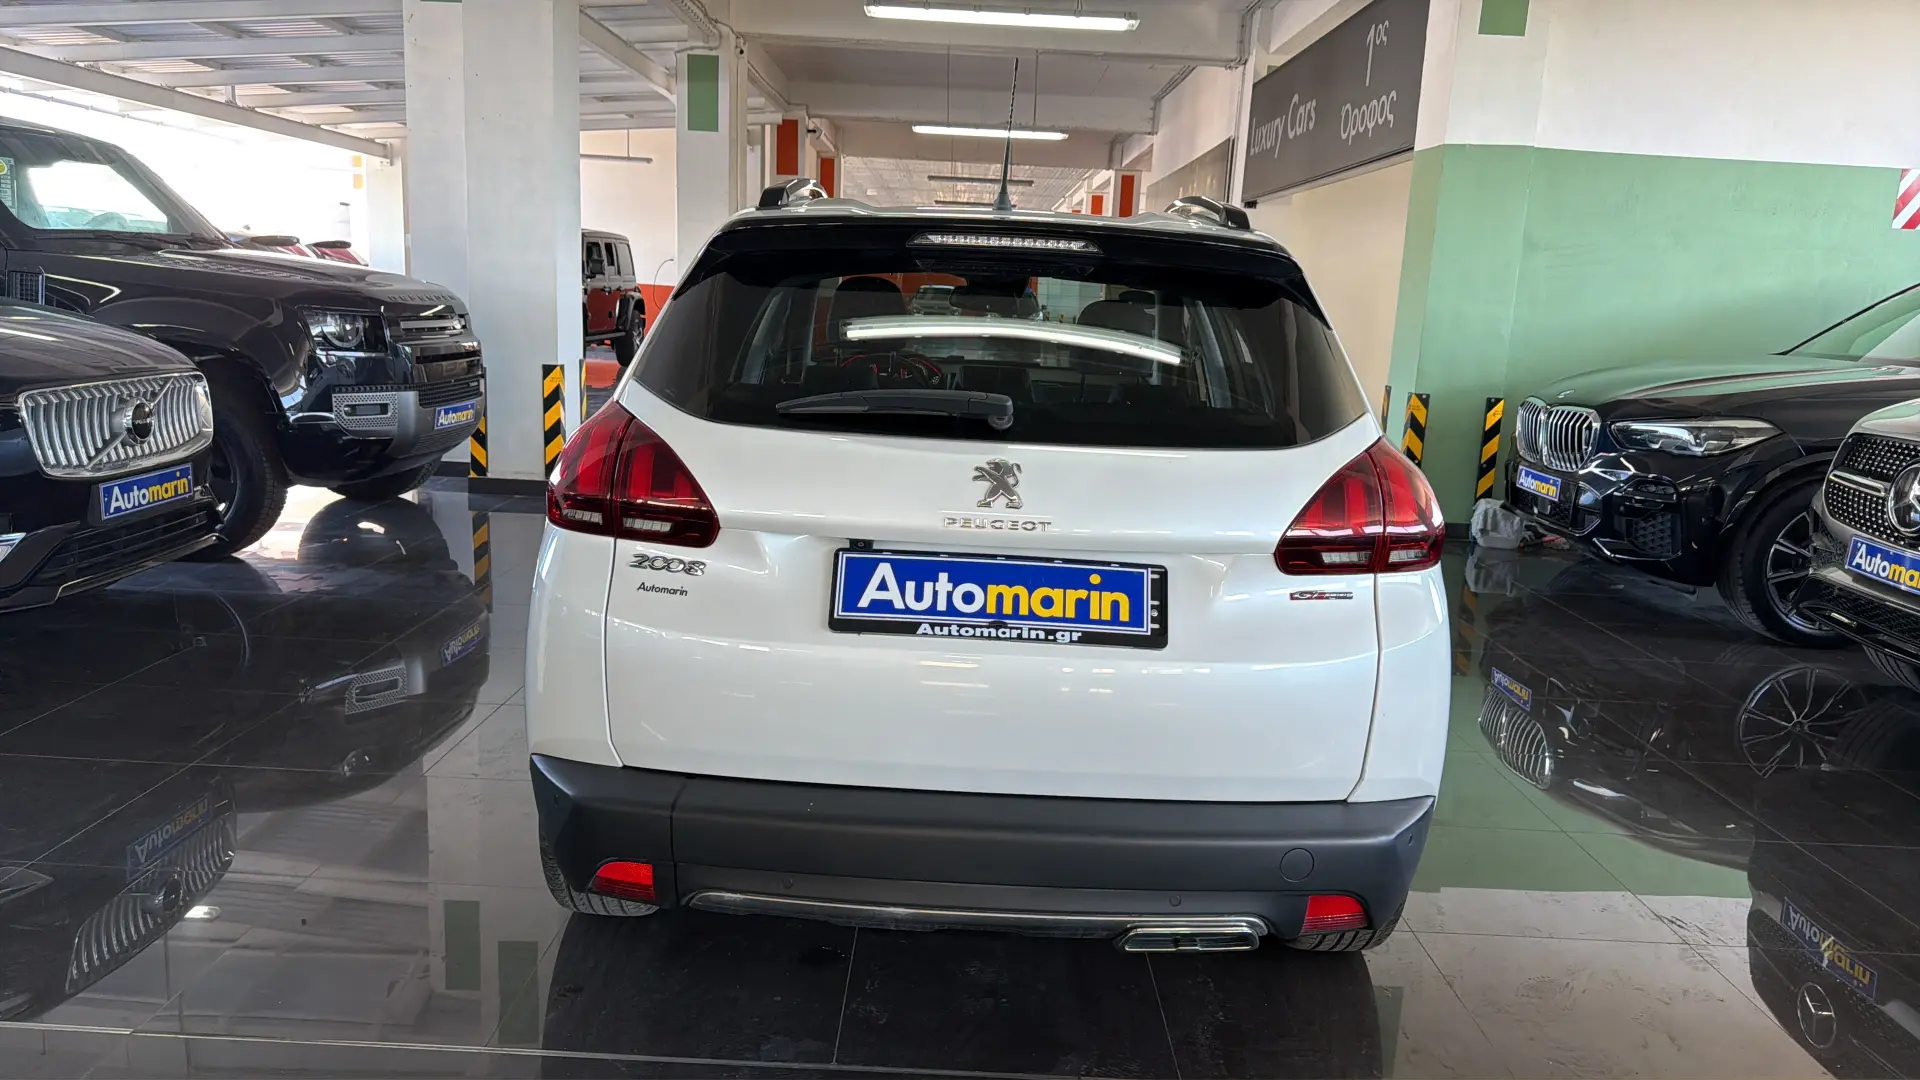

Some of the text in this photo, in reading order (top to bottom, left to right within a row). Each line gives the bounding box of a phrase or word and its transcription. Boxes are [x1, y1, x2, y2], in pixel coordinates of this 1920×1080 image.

[1250, 93, 1317, 158] Luxury Cars
[438, 404, 474, 427] Automarin
[110, 471, 189, 514] Automarin
[1518, 469, 1557, 498] Automarin
[943, 517, 1053, 532] PEUGEOT
[628, 553, 707, 576] 2008
[1851, 543, 1920, 589] Automa
[636, 582, 688, 597] Automarin
[856, 562, 1131, 623] Automarin
[915, 623, 1083, 643] Automarin.gr
